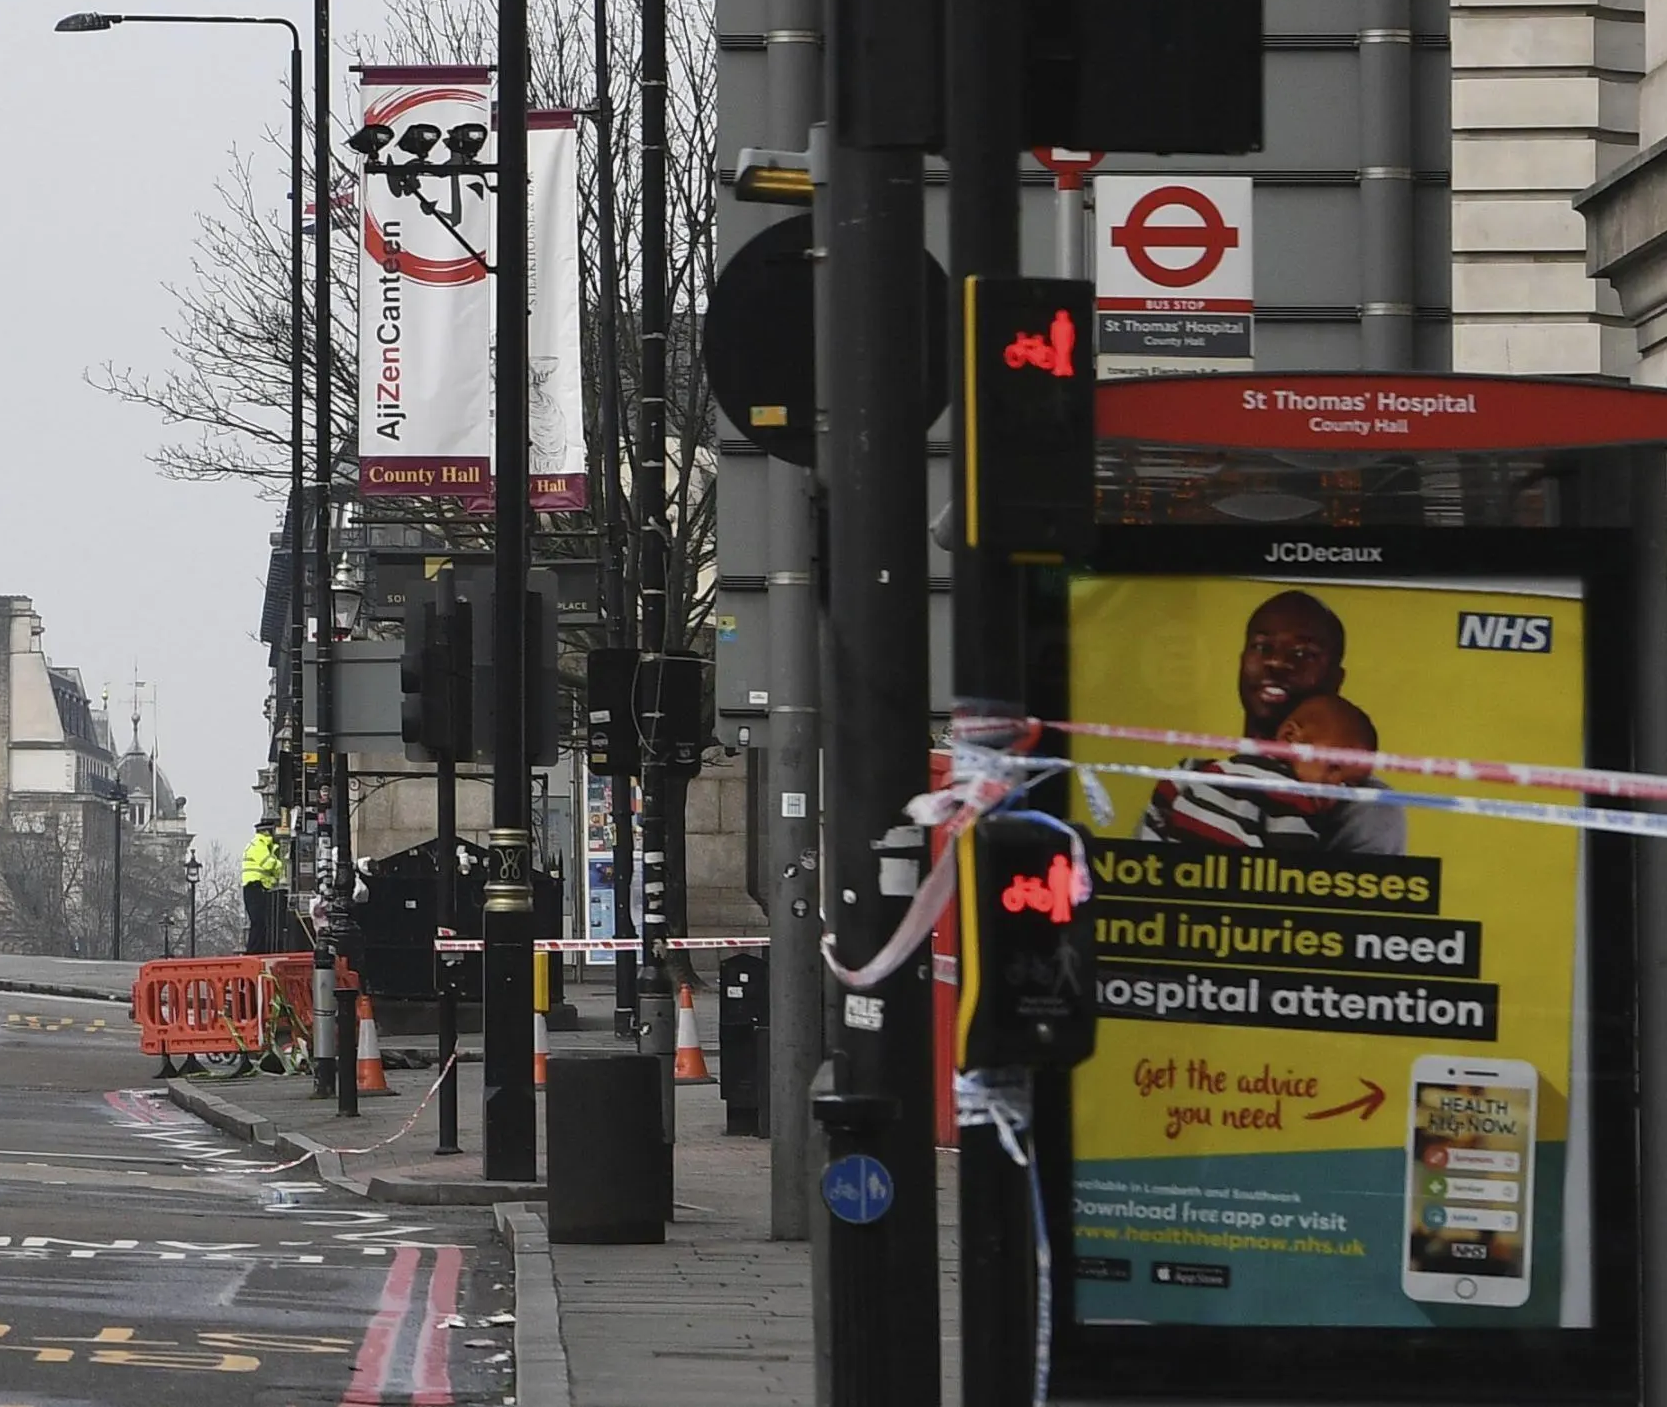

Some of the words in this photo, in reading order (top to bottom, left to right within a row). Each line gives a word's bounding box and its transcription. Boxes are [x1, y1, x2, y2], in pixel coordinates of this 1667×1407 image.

[1146, 300, 1170, 310] BUS
[1173, 300, 1206, 311] STOP
[376, 220, 405, 441] AjiZenCanteen
[1104, 320, 1121, 333] St
[1123, 320, 1183, 334] Thomas'
[1186, 321, 1244, 336] Hospital
[1143, 336, 1182, 348] County
[1184, 336, 1206, 347] Hall
[1242, 390, 1267, 411] St
[1273, 390, 1371, 413] Thomas'
[1377, 391, 1477, 417] Hospital
[1308, 416, 1372, 437] County
[1375, 418, 1409, 434] Hall
[369, 465, 435, 487] County
[441, 466, 480, 485] Hall
[537, 480, 567, 493] Hall
[1264, 543, 1383, 564] JCDecaux
[1459, 614, 1551, 653] NHS
[1174, 855, 1227, 891] all
[1240, 857, 1430, 903] illnesses
[1178, 914, 1343, 960] injuries
[1354, 927, 1466, 966] need
[1271, 980, 1484, 1029] attention
[1134, 1058, 1177, 1099] Get
[1187, 1058, 1227, 1094] the
[1237, 1062, 1320, 1100] advice
[1165, 1106, 1212, 1139] you
[1222, 1100, 1283, 1131] need
[1440, 1097, 1509, 1116] HEALTH
[1182, 1201, 1219, 1224] free
[1222, 1207, 1266, 1229] app
[1269, 1212, 1293, 1229] or
[1298, 1211, 1348, 1232] visit
